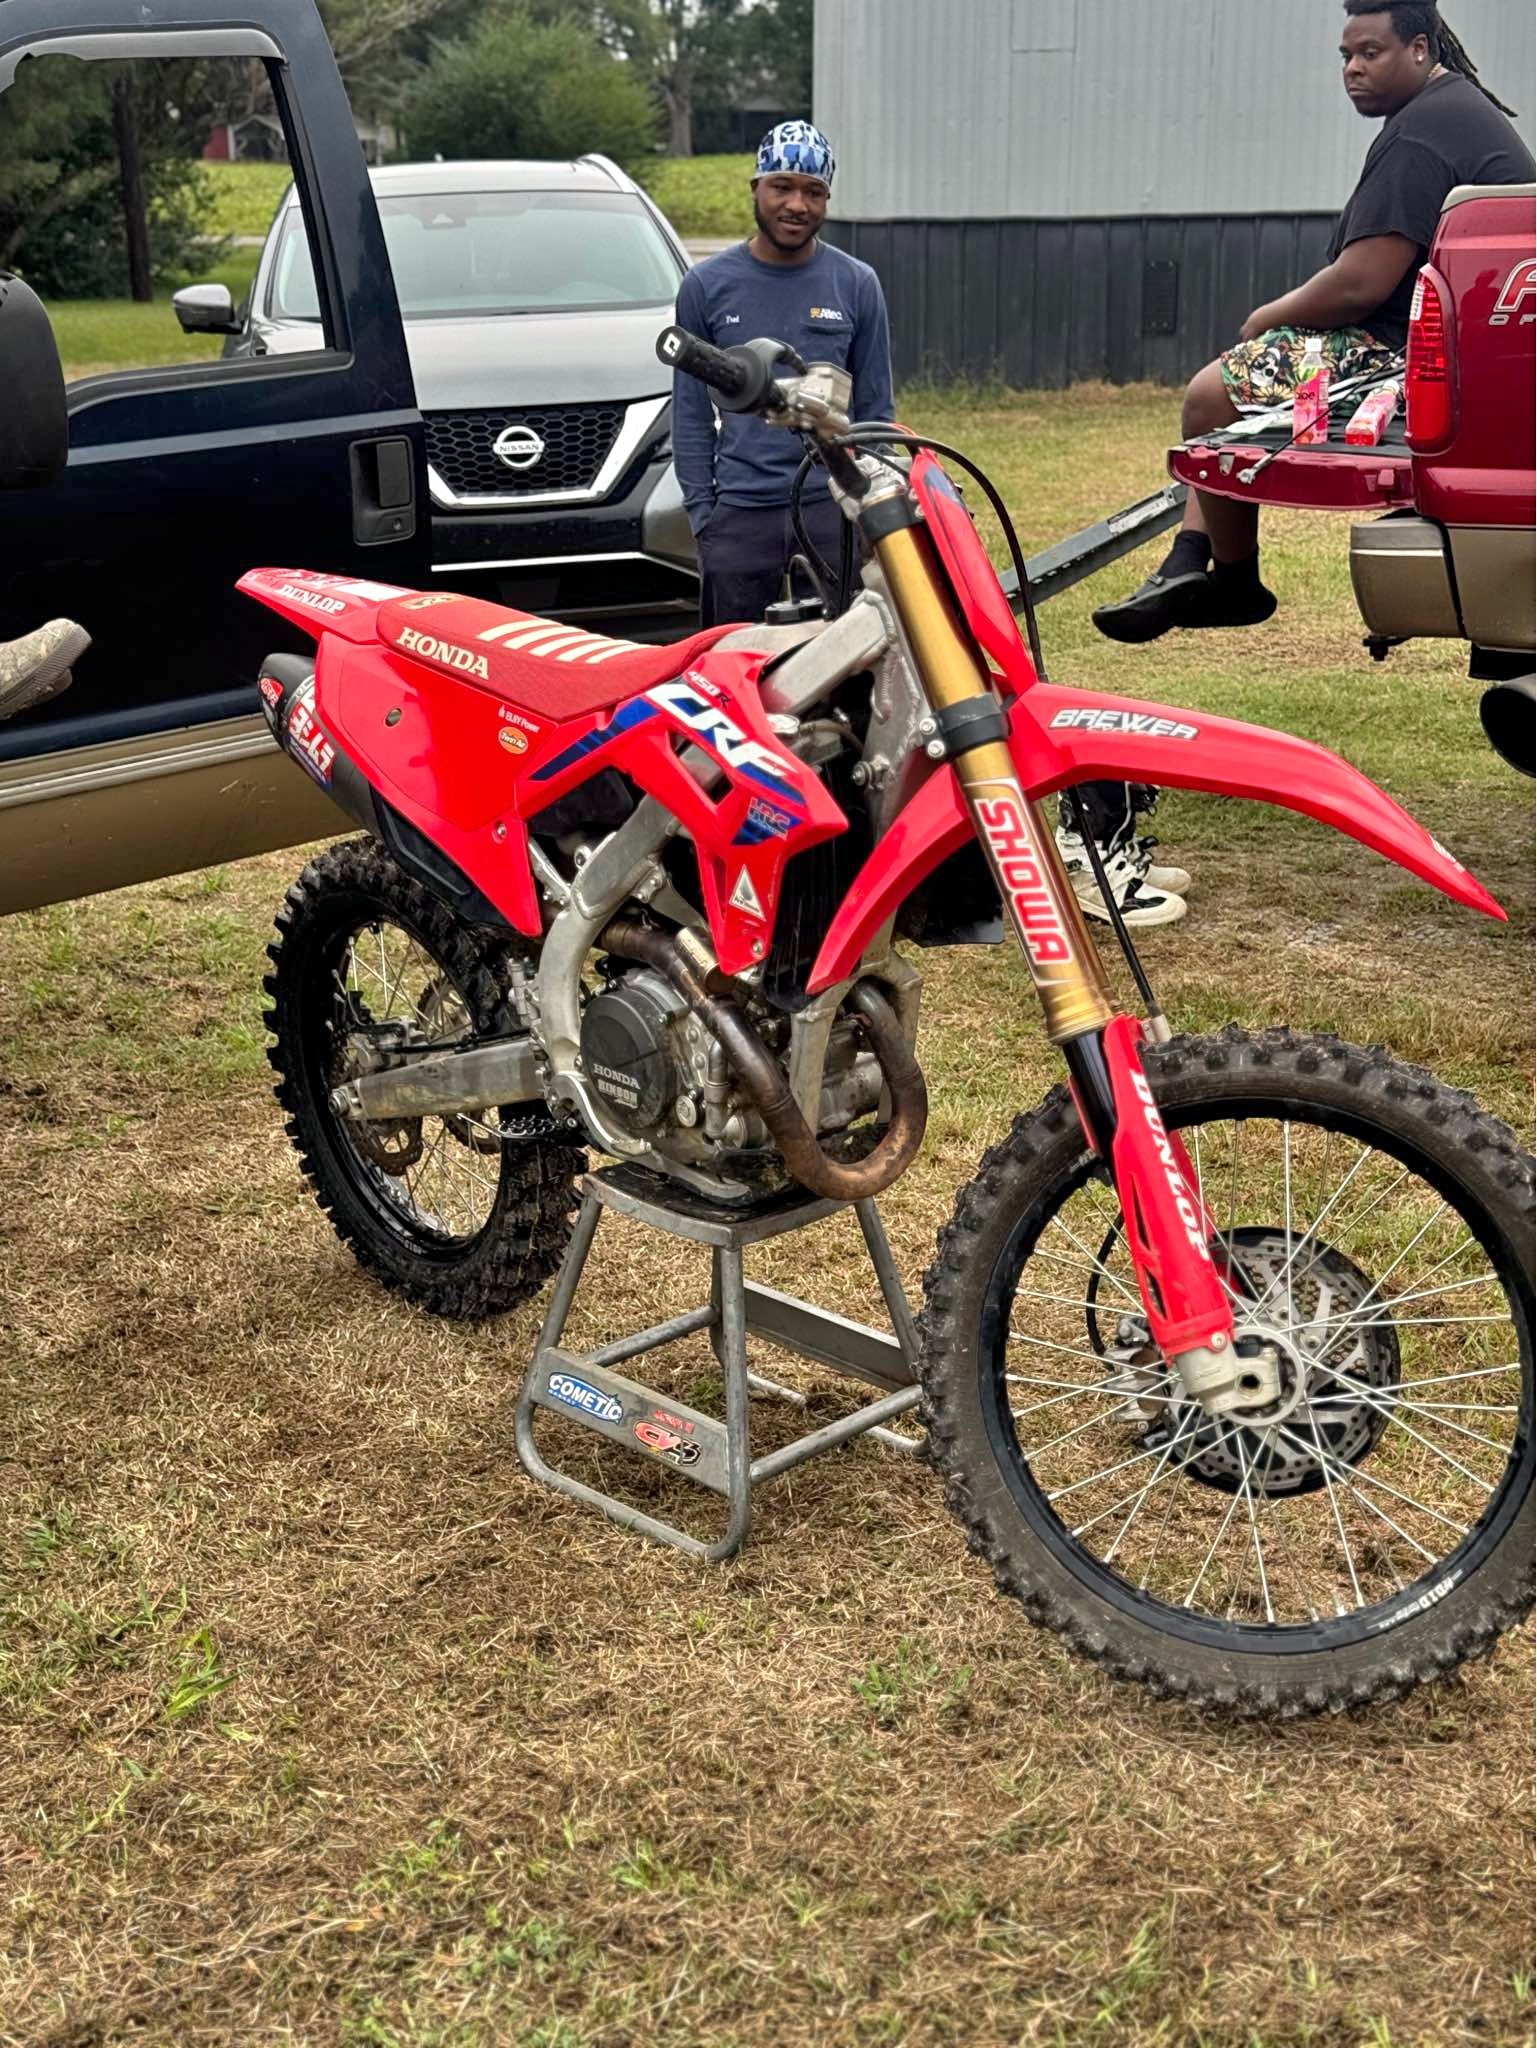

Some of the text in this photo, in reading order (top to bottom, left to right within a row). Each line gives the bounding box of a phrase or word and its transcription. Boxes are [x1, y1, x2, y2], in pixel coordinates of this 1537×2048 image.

[499, 443, 541, 453] NISSAN
[275, 584, 347, 615] DUNLOP
[396, 626, 489, 680] HONDA
[645, 683, 799, 778] CRF
[1048, 708, 1199, 739] BREWER
[974, 797, 1074, 965] SHOWA
[593, 1063, 641, 1090] HONDA
[1129, 1069, 1210, 1262] DUNLOP
[549, 1374, 623, 1420] COMETIC
